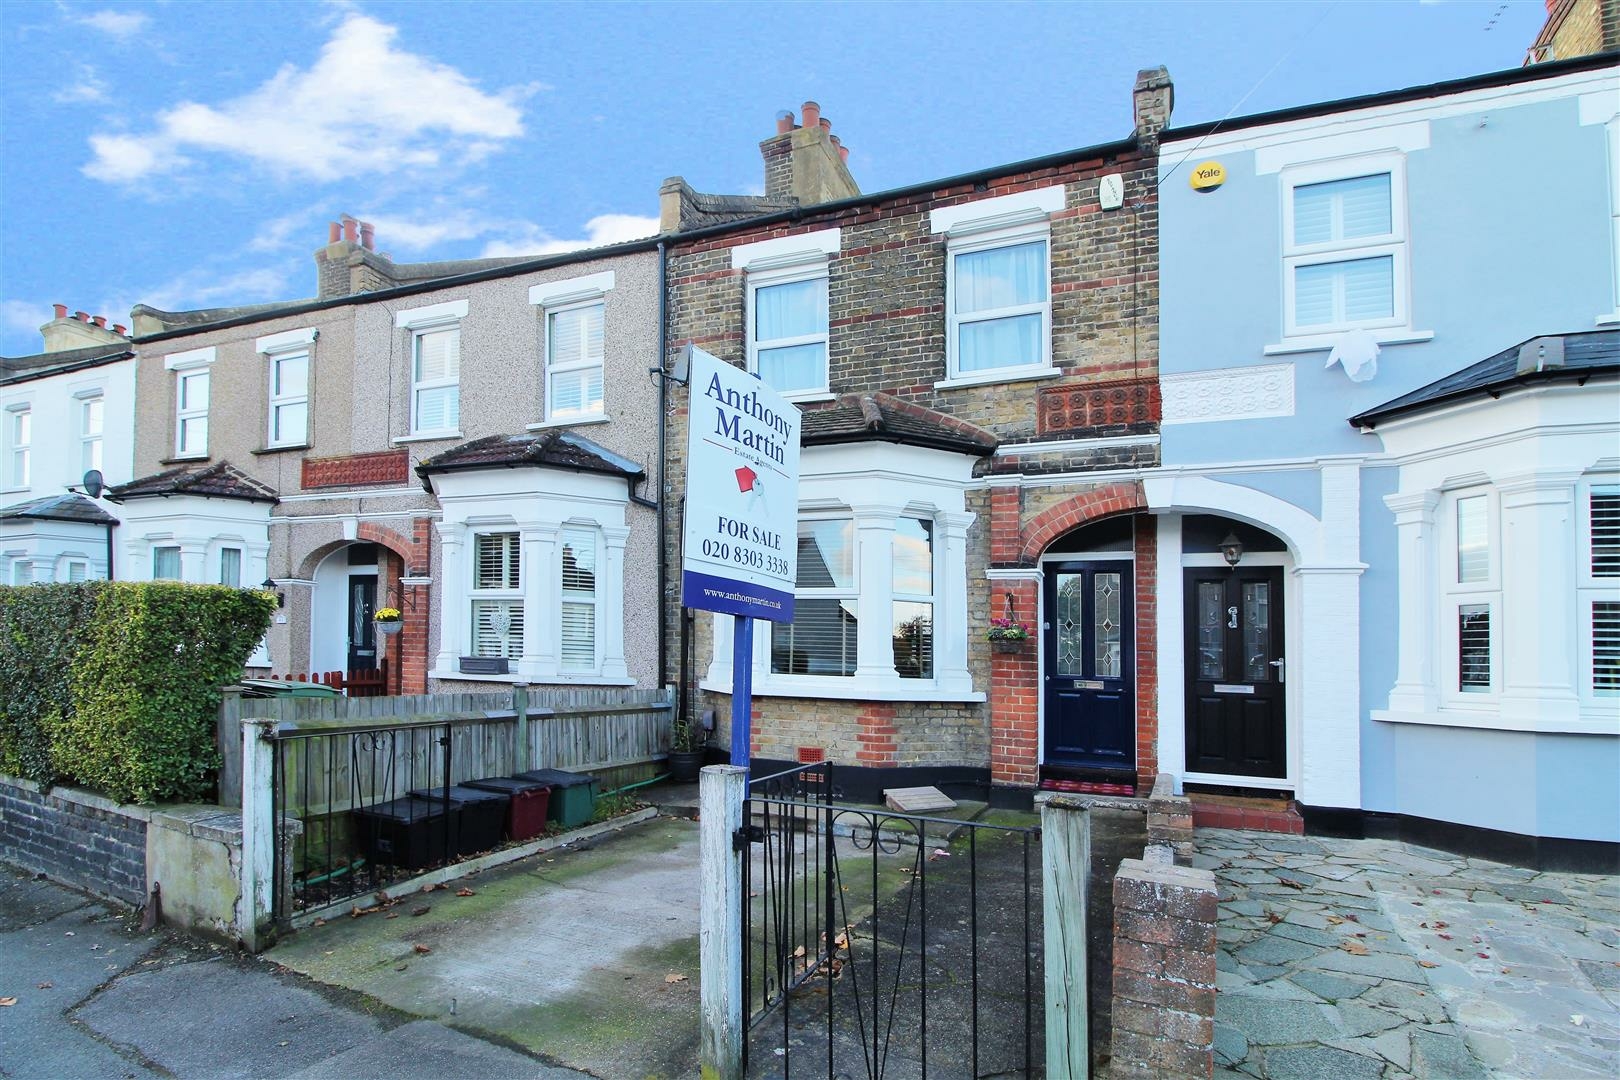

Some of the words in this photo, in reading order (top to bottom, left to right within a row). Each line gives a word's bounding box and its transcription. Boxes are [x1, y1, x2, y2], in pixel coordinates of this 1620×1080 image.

[1197, 168, 1221, 179] Yale
[705, 372, 792, 445] Anthony
[715, 407, 784, 465] Martin
[734, 447, 755, 462] Estate
[718, 516, 749, 541] FOR
[752, 526, 781, 551] SALE
[702, 539, 729, 560] 020
[734, 546, 763, 569] 8303
[766, 555, 789, 576] 3338
[703, 588, 782, 610] www.anthonymartin.co.uk
